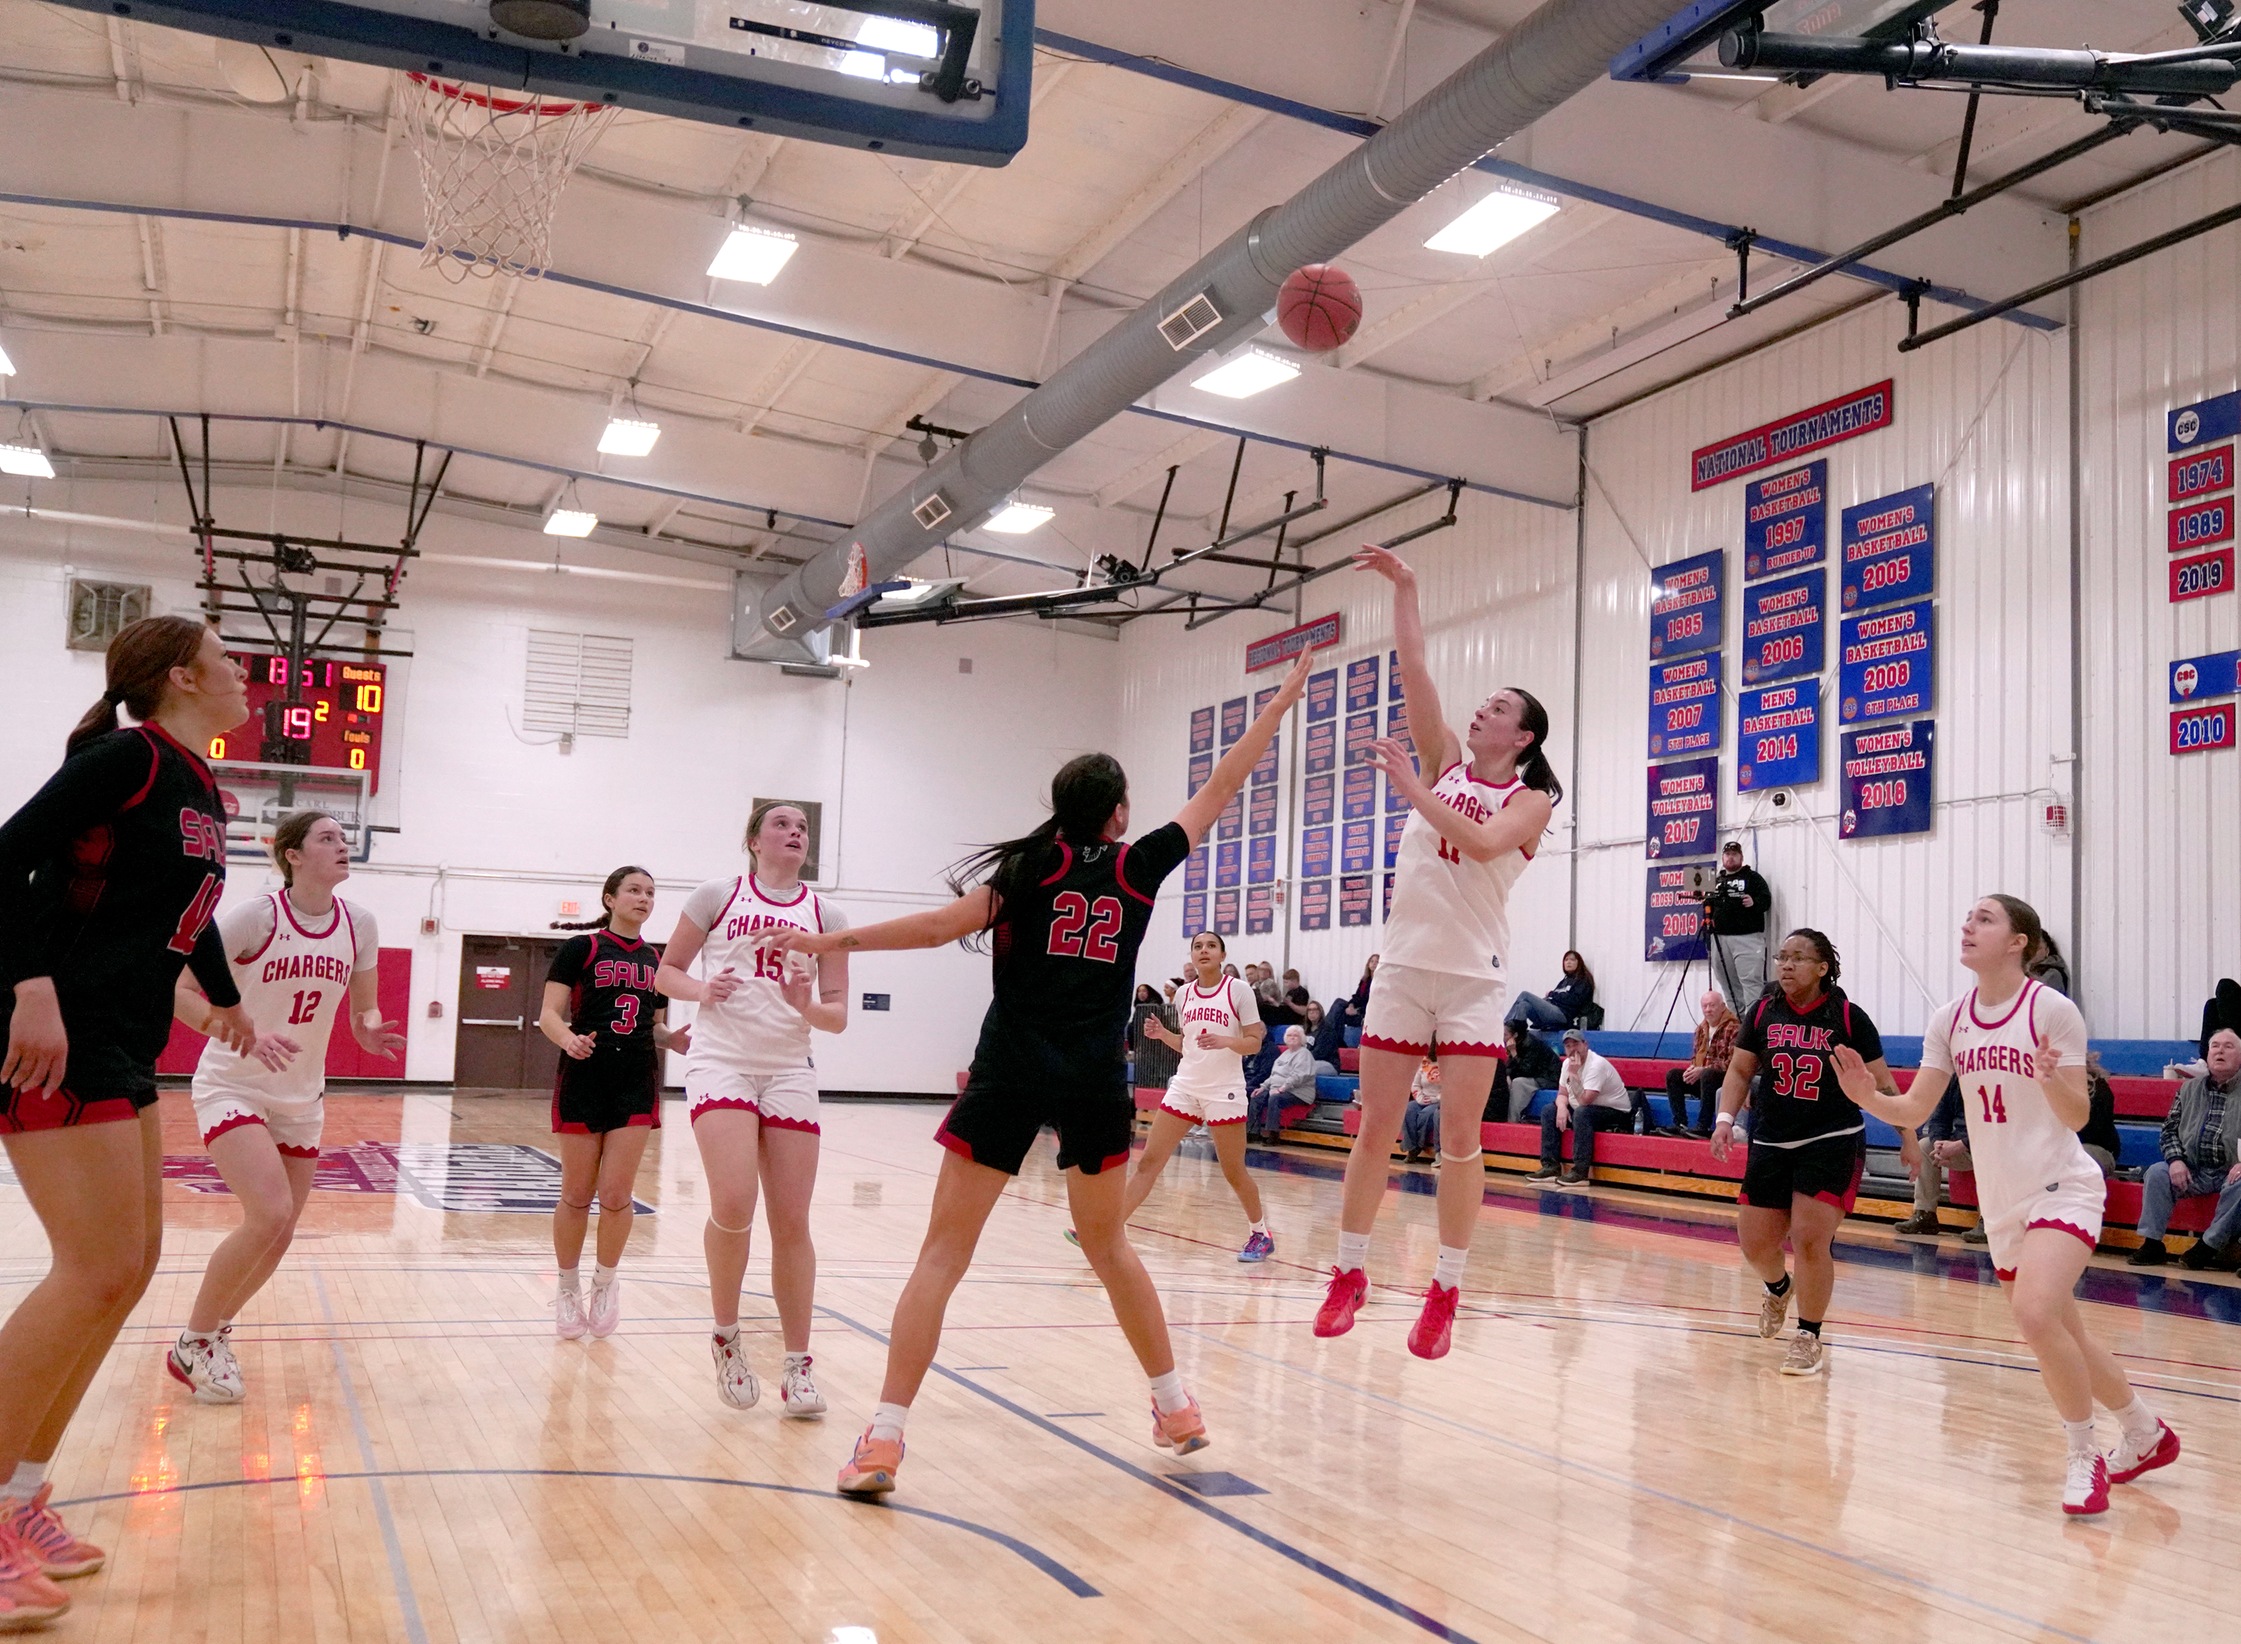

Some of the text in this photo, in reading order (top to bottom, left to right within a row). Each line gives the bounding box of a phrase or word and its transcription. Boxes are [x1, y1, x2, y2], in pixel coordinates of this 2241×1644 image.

[1697, 393, 1884, 483] NATIONAL TOURNAMENTS
[2177, 419, 2197, 435] CSC
[1761, 468, 1810, 498] WOMEN'S
[2178, 456, 2224, 494] 1974
[1751, 487, 1820, 523] BASKETBALL
[1766, 516, 1805, 550] 1997
[1857, 505, 1914, 536] WOMEN'S
[2178, 507, 2224, 544] 1989
[1767, 545, 1816, 570] RUNNER-UP
[1847, 523, 1928, 562] BASKETBALL
[1664, 566, 1709, 590] WOMEN'S
[1863, 555, 1910, 592] 2005
[2178, 559, 2223, 595] 2019
[1654, 585, 1716, 615] BASKETBALL
[1759, 587, 1808, 614] WOMEN'S
[1667, 612, 1702, 642] 1985
[1748, 606, 1818, 638] BASKETBALL
[1858, 610, 1915, 639] WOMEN'S
[1762, 635, 1803, 667] 2006
[1846, 631, 1927, 664] BASKETBALL
[343, 666, 382, 682] Guests
[1663, 659, 1708, 684] WOMEN'S
[1864, 660, 1910, 693] 2008
[356, 684, 382, 713] 10
[1654, 678, 1716, 705] BASKETBALL
[1761, 688, 1796, 711] MEN'S
[1865, 693, 1919, 716] 6TH PLACE
[283, 708, 311, 740] 19
[314, 700, 329, 722] 2
[1667, 703, 1703, 731] 2007
[1744, 706, 1814, 735] BASKETBALL
[1668, 732, 1710, 751] 5TH PLACE
[1856, 729, 1912, 754] WOMEN'S
[2177, 715, 2225, 748] 2010
[209, 738, 226, 759] 0
[350, 748, 365, 770] 0
[1757, 733, 1797, 764] 2014
[1846, 750, 1926, 778] VOLLEYBALL
[1660, 774, 1705, 796] WOMEN'S
[1862, 779, 1906, 810] 2018
[1652, 793, 1713, 817] VOLLEYBALL
[1664, 817, 1700, 845] 2017
[562, 901, 579, 913] EXIT
[1651, 892, 1673, 908] CROSS
[1047, 890, 1123, 964] 22
[1663, 912, 1698, 937] 2019
[262, 954, 351, 987] CHARGERS
[754, 947, 784, 981] 15
[288, 990, 323, 1026] 12
[611, 993, 640, 1036] 3
[1767, 1023, 1835, 1051] SAUK
[1772, 1053, 1822, 1101] 32
[1977, 1084, 2007, 1124] 14
